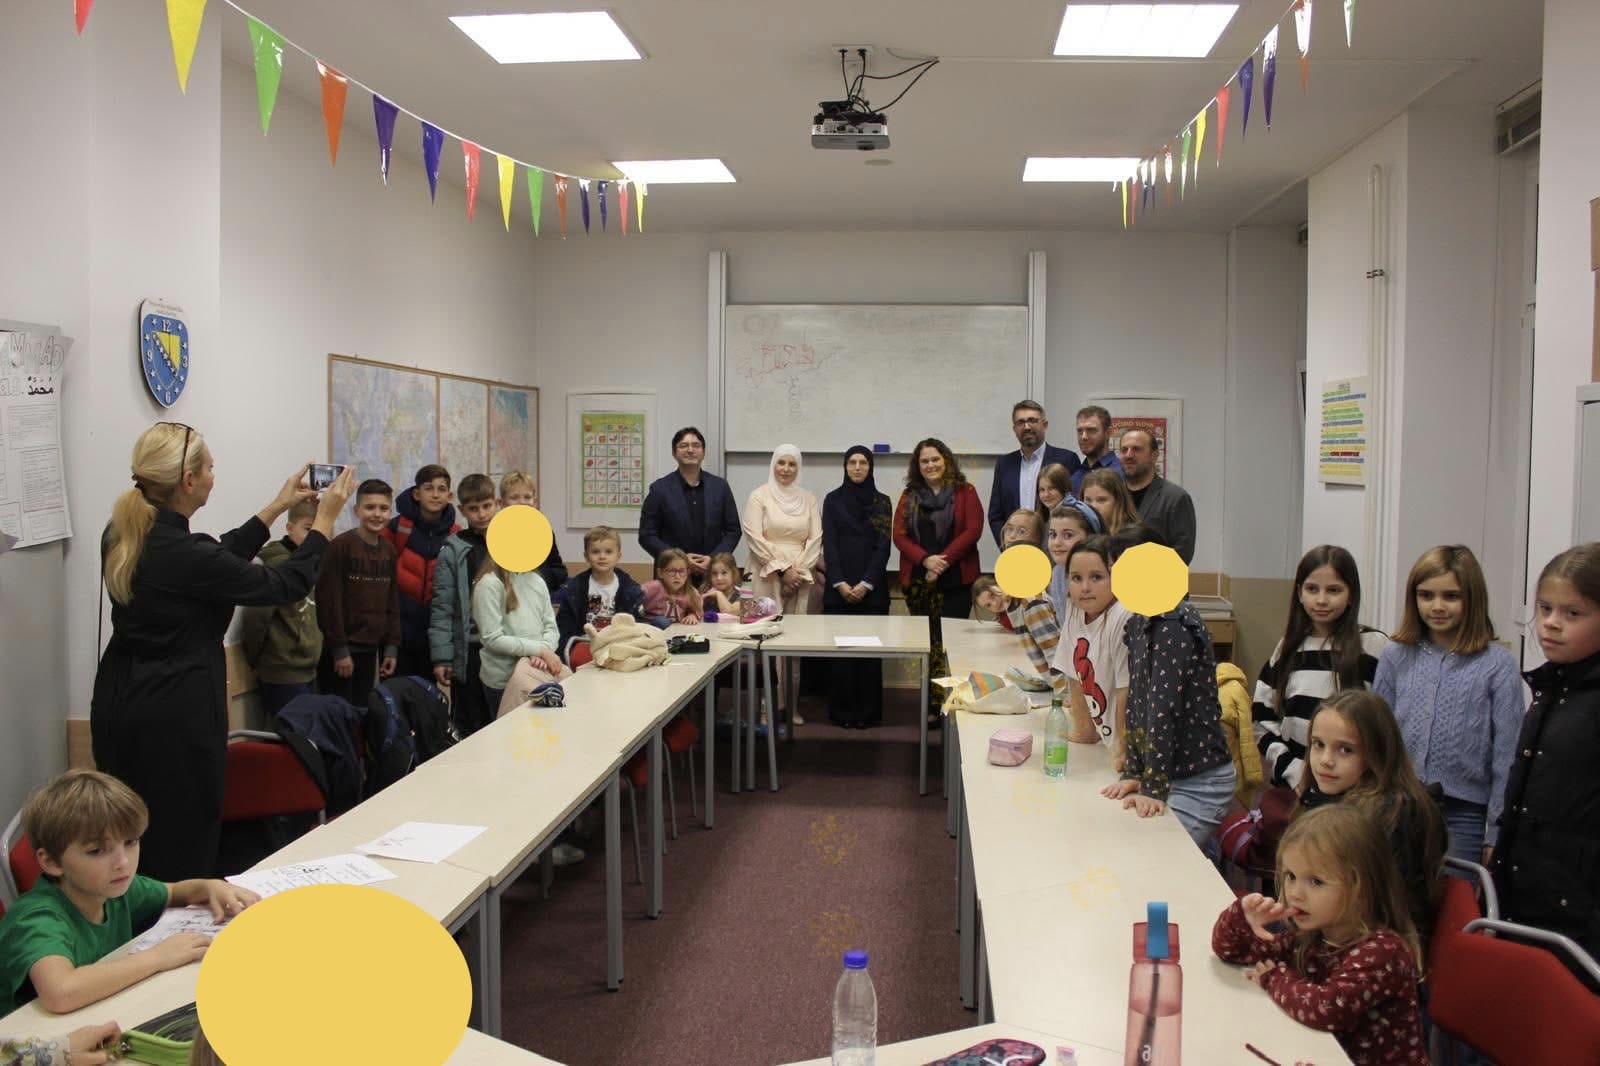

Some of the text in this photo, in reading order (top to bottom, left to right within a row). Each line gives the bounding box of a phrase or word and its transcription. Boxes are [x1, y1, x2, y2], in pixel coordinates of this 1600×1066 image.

[162, 320, 171, 332] 12
[147, 350, 153, 362] 9
[182, 356, 189, 368] 3
[165, 391, 171, 404] 6
[1142, 1044, 1151, 1062] a
